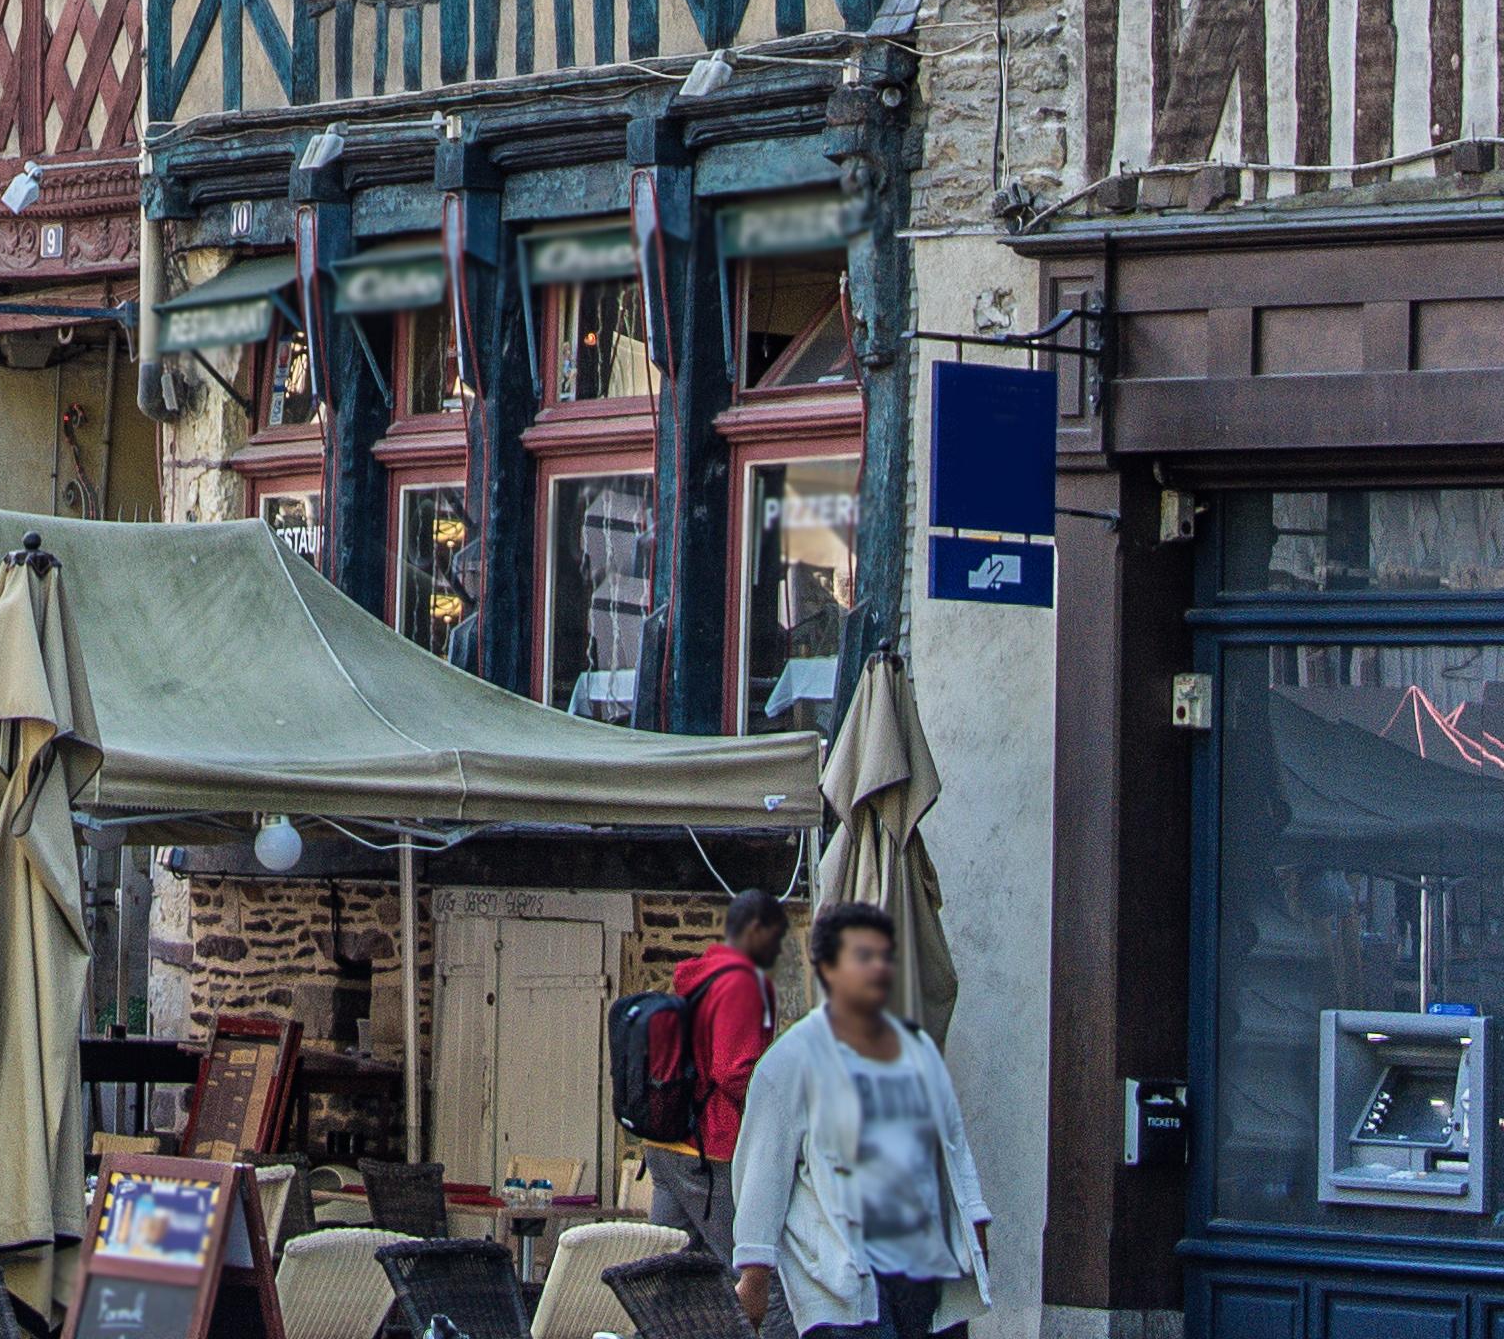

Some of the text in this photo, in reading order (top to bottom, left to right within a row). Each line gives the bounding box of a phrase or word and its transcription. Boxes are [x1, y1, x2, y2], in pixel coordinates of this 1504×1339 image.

[232, 205, 248, 235] 10
[47, 227, 56, 255] 9
[1147, 1116, 1181, 1129] TICKETS
